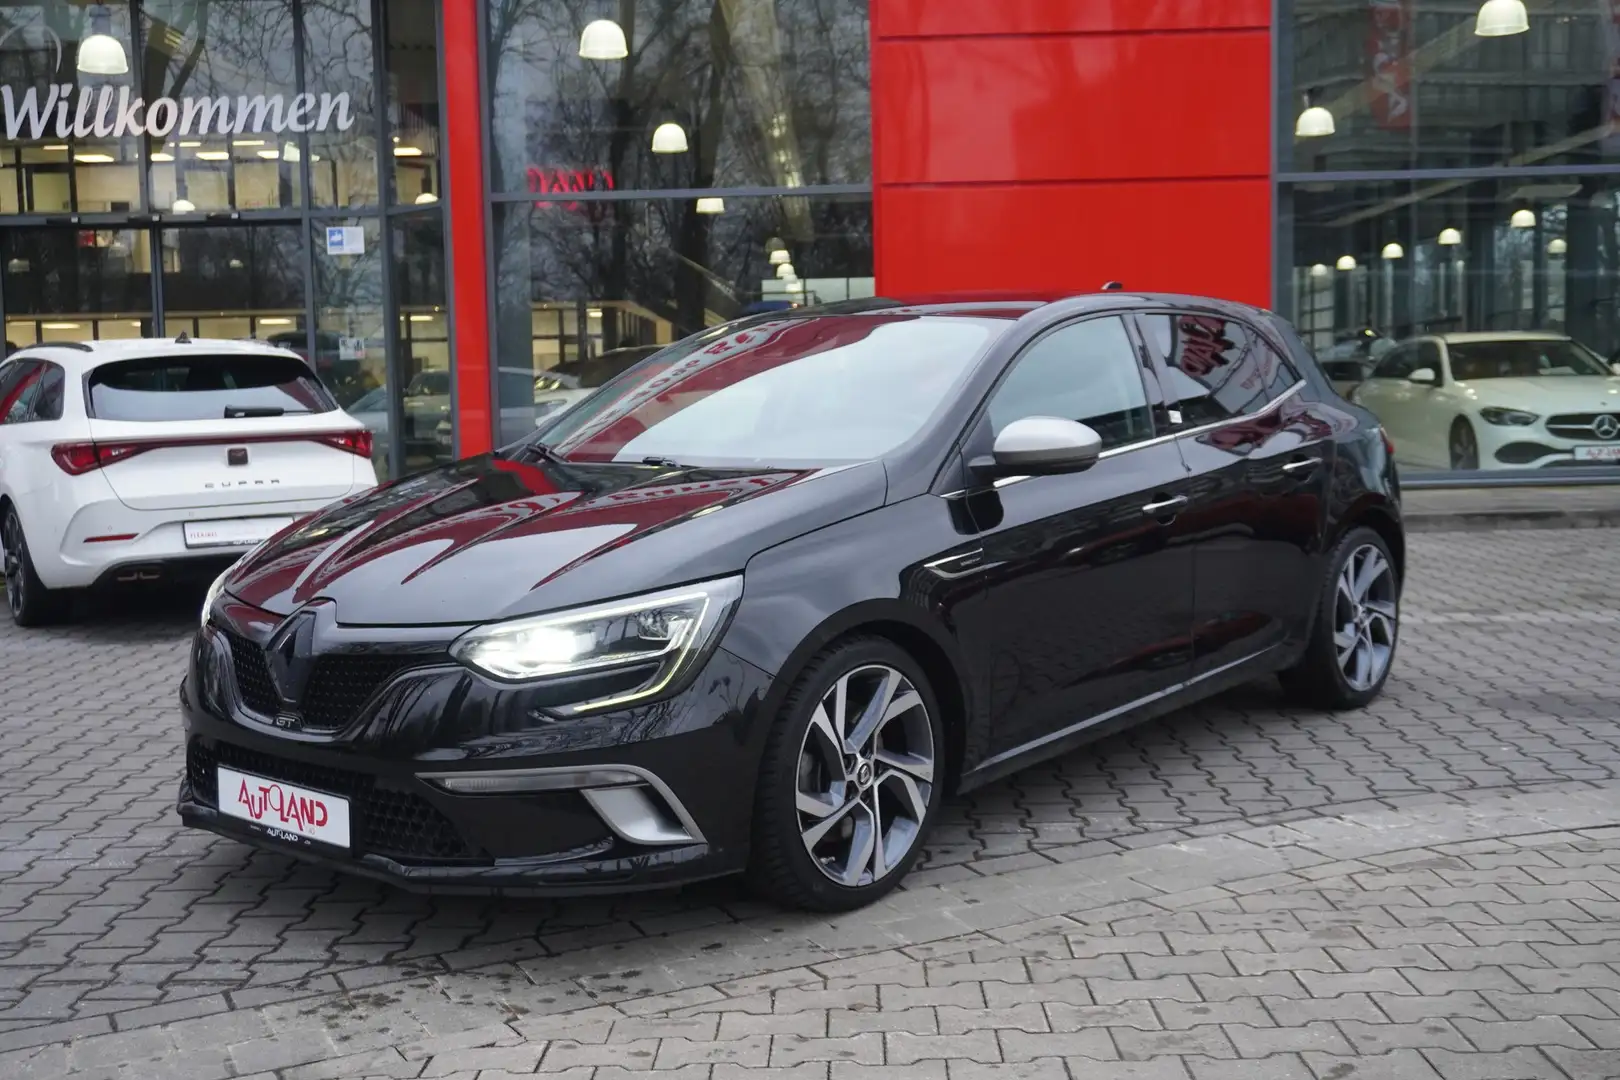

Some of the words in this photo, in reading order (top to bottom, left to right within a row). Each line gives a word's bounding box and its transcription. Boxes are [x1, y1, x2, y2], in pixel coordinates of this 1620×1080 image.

[1, 83, 355, 140] Willkommen
[204, 478, 280, 489] CUPRA
[276, 716, 295, 728] GT
[238, 777, 328, 832] AUTOLAND
